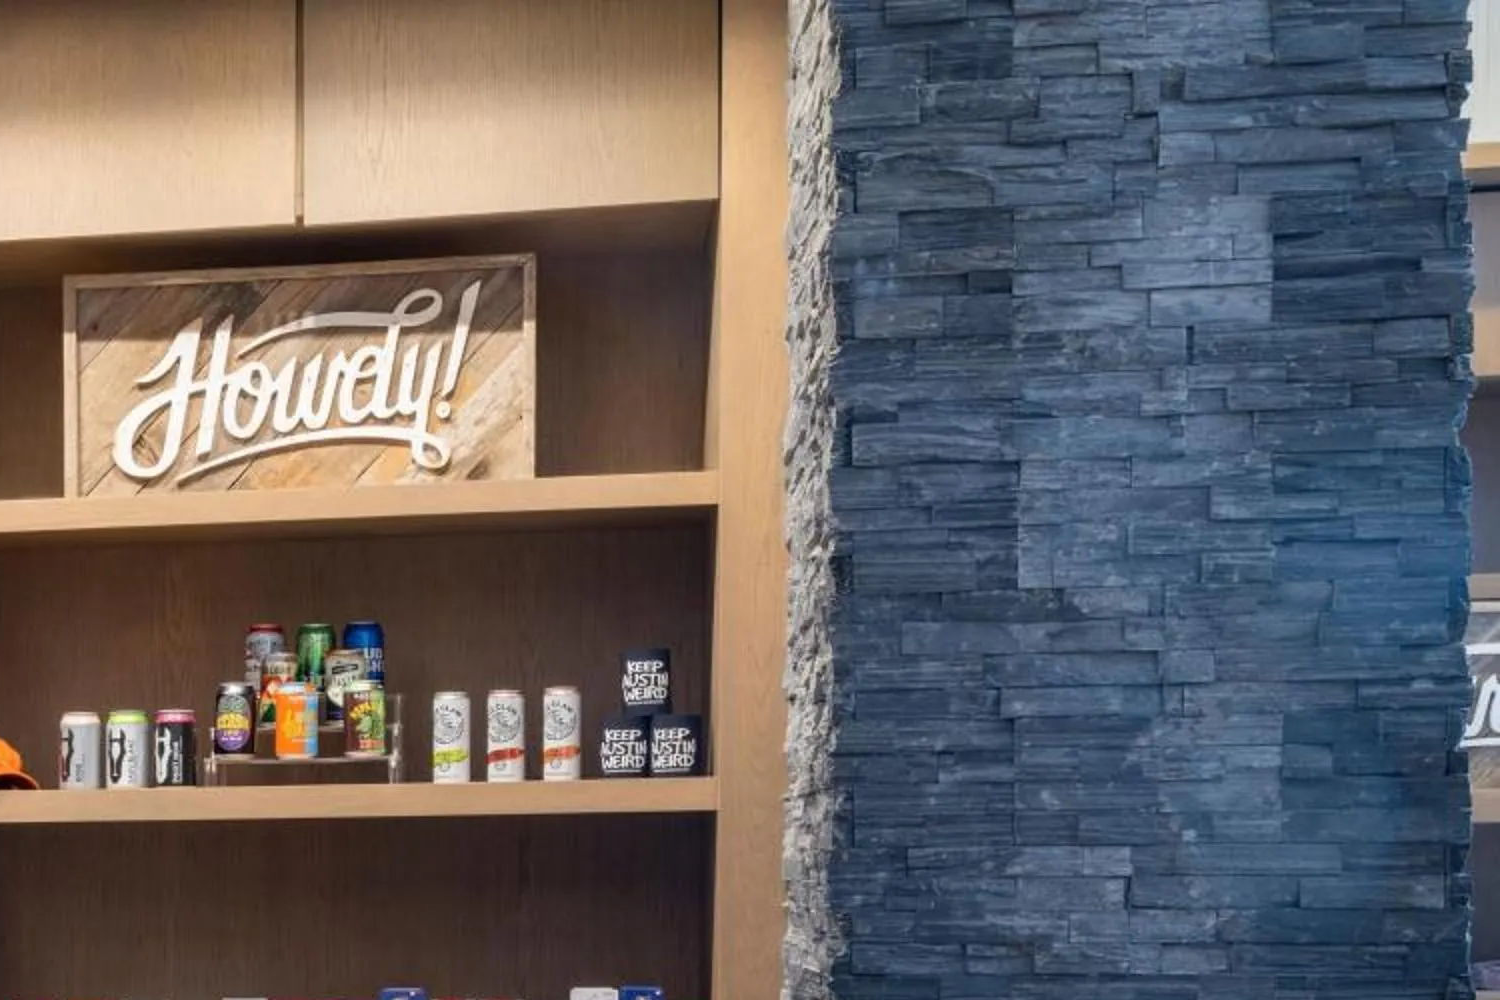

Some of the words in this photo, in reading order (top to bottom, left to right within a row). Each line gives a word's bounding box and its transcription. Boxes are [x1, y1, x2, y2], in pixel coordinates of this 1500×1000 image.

[113, 279, 482, 479] Howdy!
[627, 660, 664, 673] KEEP
[622, 673, 669, 688] AUSTIN
[623, 686, 668, 701] WEIRD
[605, 728, 642, 741] KEEP
[653, 728, 690, 741] KEEP
[601, 740, 647, 755] AUSTIN
[651, 739, 696, 755] AUSTIN
[601, 753, 644, 769] WEIRD
[652, 753, 695, 769] WEIRD
